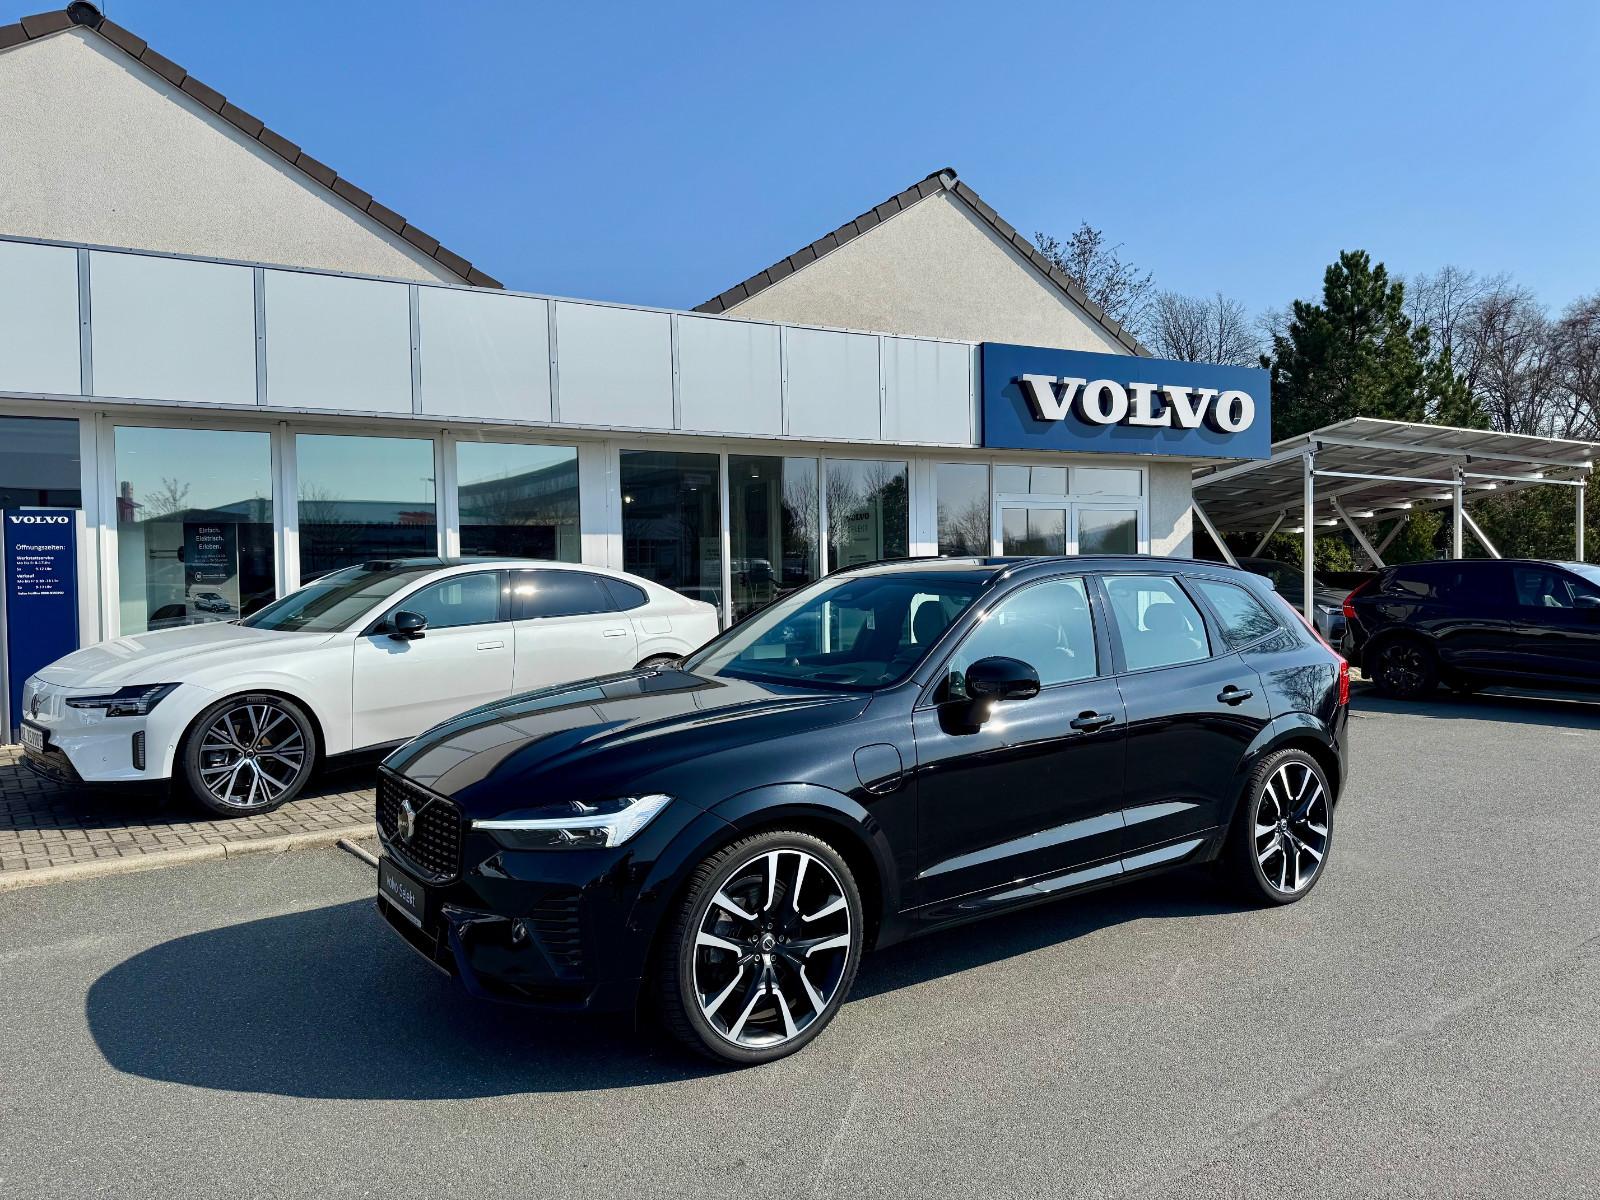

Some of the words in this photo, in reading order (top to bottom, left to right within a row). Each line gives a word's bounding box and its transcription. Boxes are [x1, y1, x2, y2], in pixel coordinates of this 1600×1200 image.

[1020, 373, 1255, 433] VOLVO
[9, 515, 69, 524] VOLVO
[16, 544, 66, 552] Öffnungszeiten:
